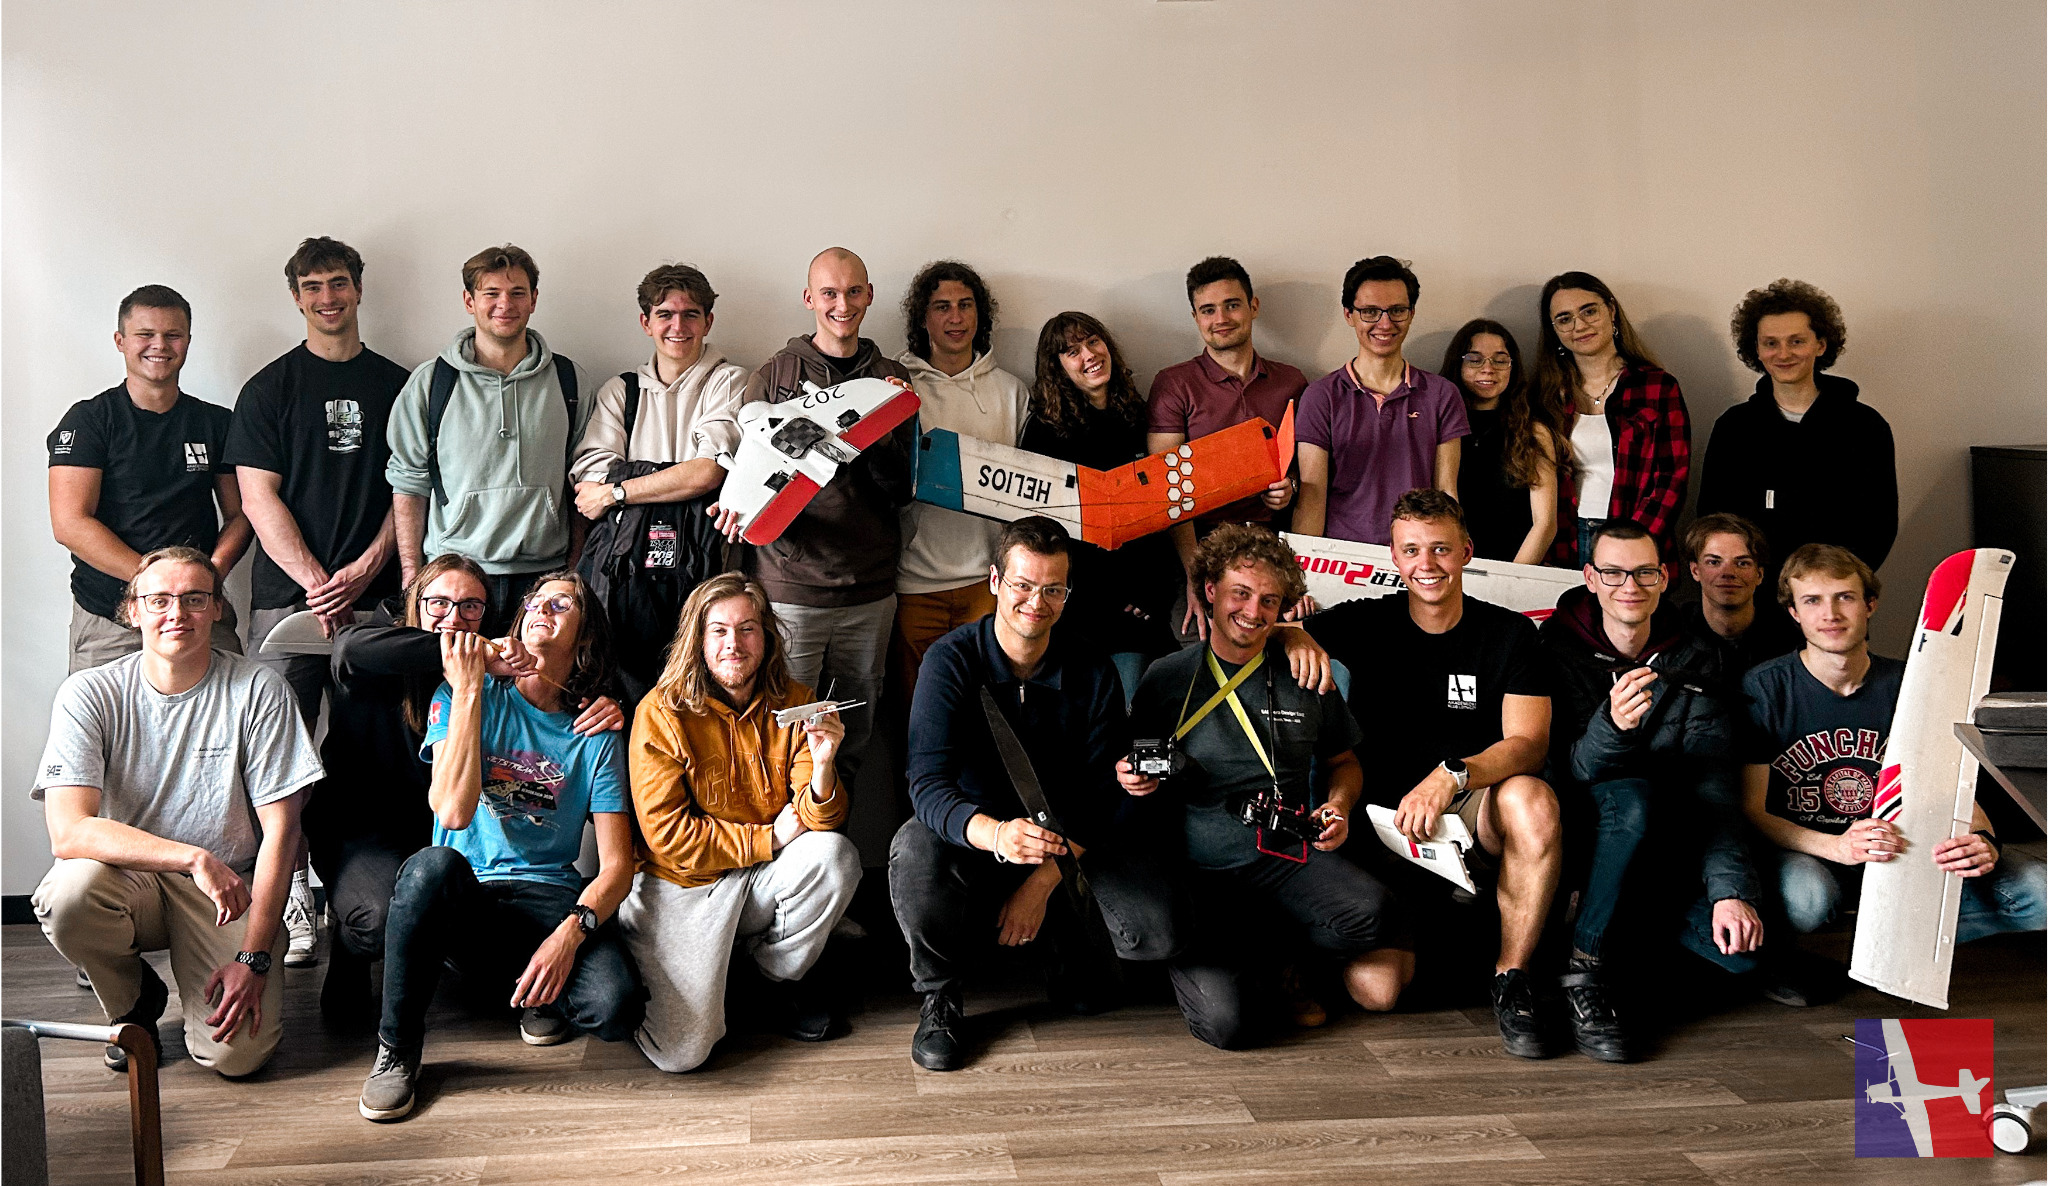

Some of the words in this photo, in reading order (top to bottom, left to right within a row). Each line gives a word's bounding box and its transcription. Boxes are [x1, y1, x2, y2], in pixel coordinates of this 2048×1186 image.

[799, 385, 845, 408] 202
[978, 464, 1052, 504] HELIOS
[648, 551, 674, 559] BULL
[654, 558, 674, 566] PIT
[1787, 786, 1820, 813] 15
